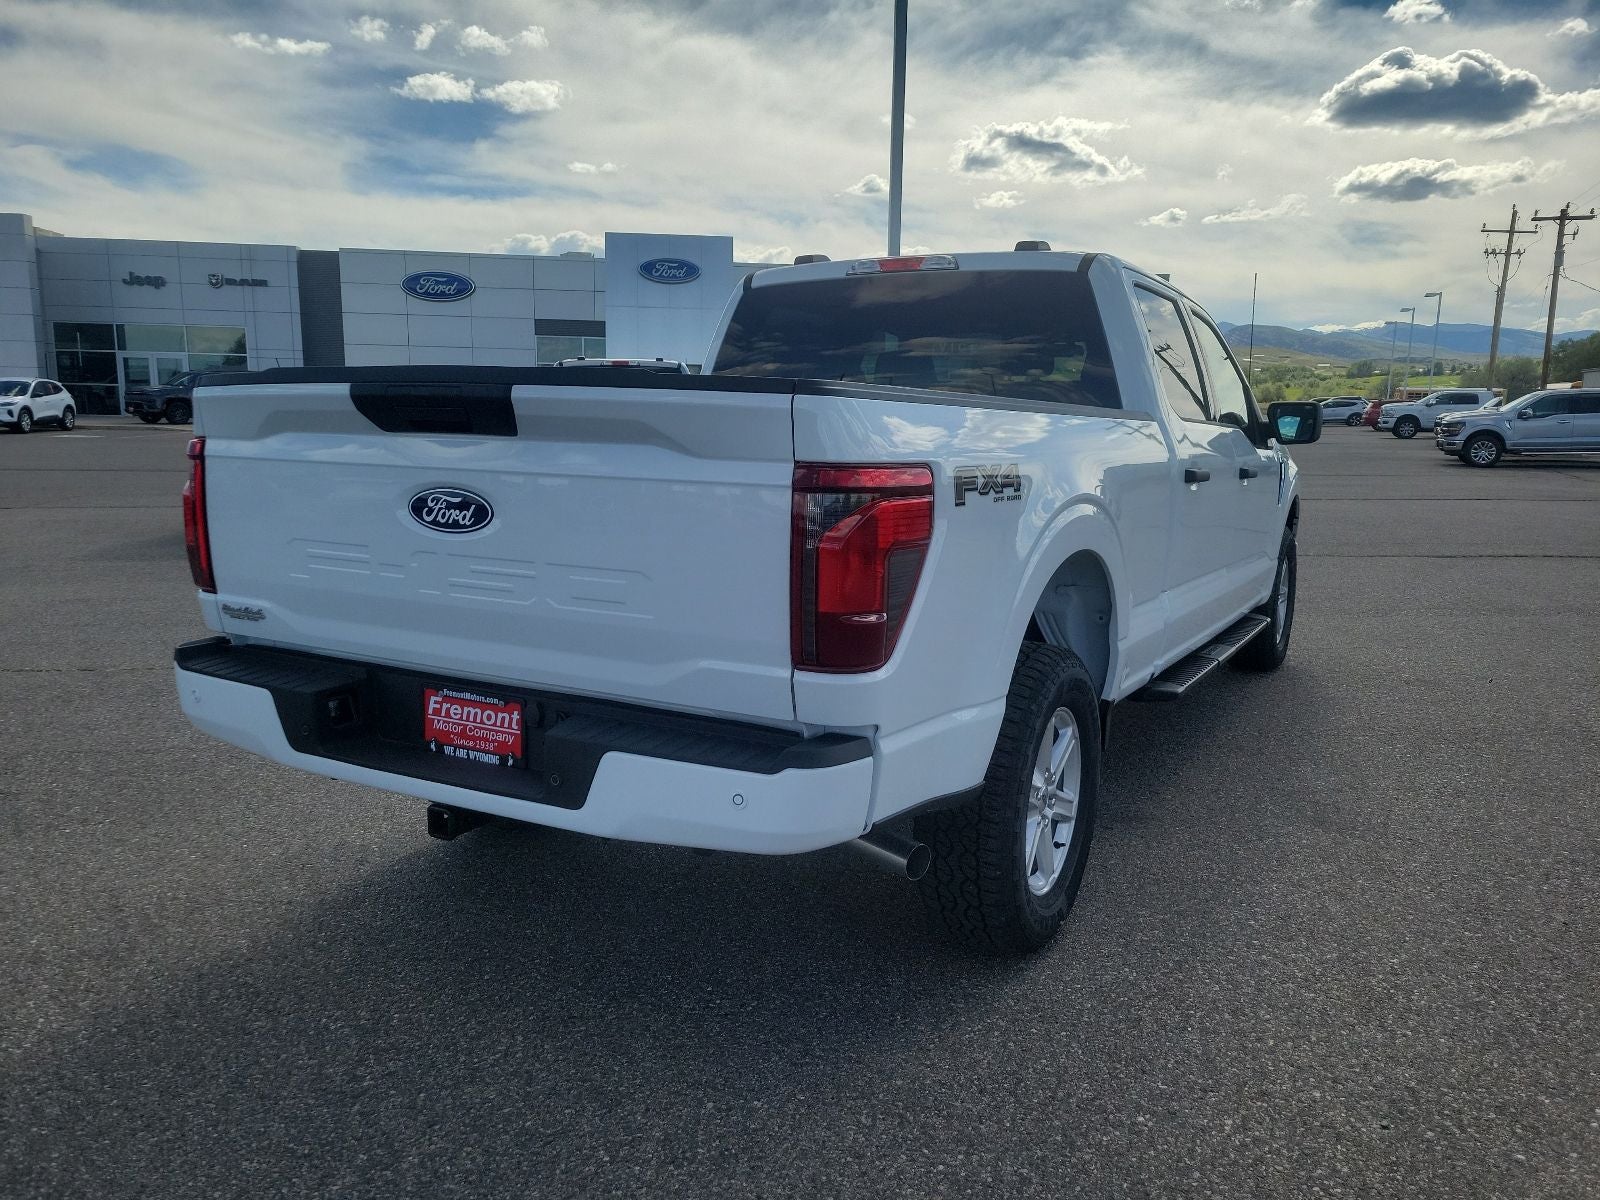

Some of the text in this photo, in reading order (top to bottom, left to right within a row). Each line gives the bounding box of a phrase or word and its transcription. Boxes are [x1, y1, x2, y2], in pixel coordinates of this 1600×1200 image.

[652, 261, 688, 278] Ford
[122, 271, 167, 289] Jeep
[416, 276, 458, 294] Ford
[953, 463, 1022, 507] FX4
[1006, 494, 1022, 502] ROAD
[422, 494, 476, 526] Ford
[428, 695, 520, 730] Fremont
[433, 719, 515, 745] Motor Company
[444, 745, 500, 765] WE ARE WYOMING
